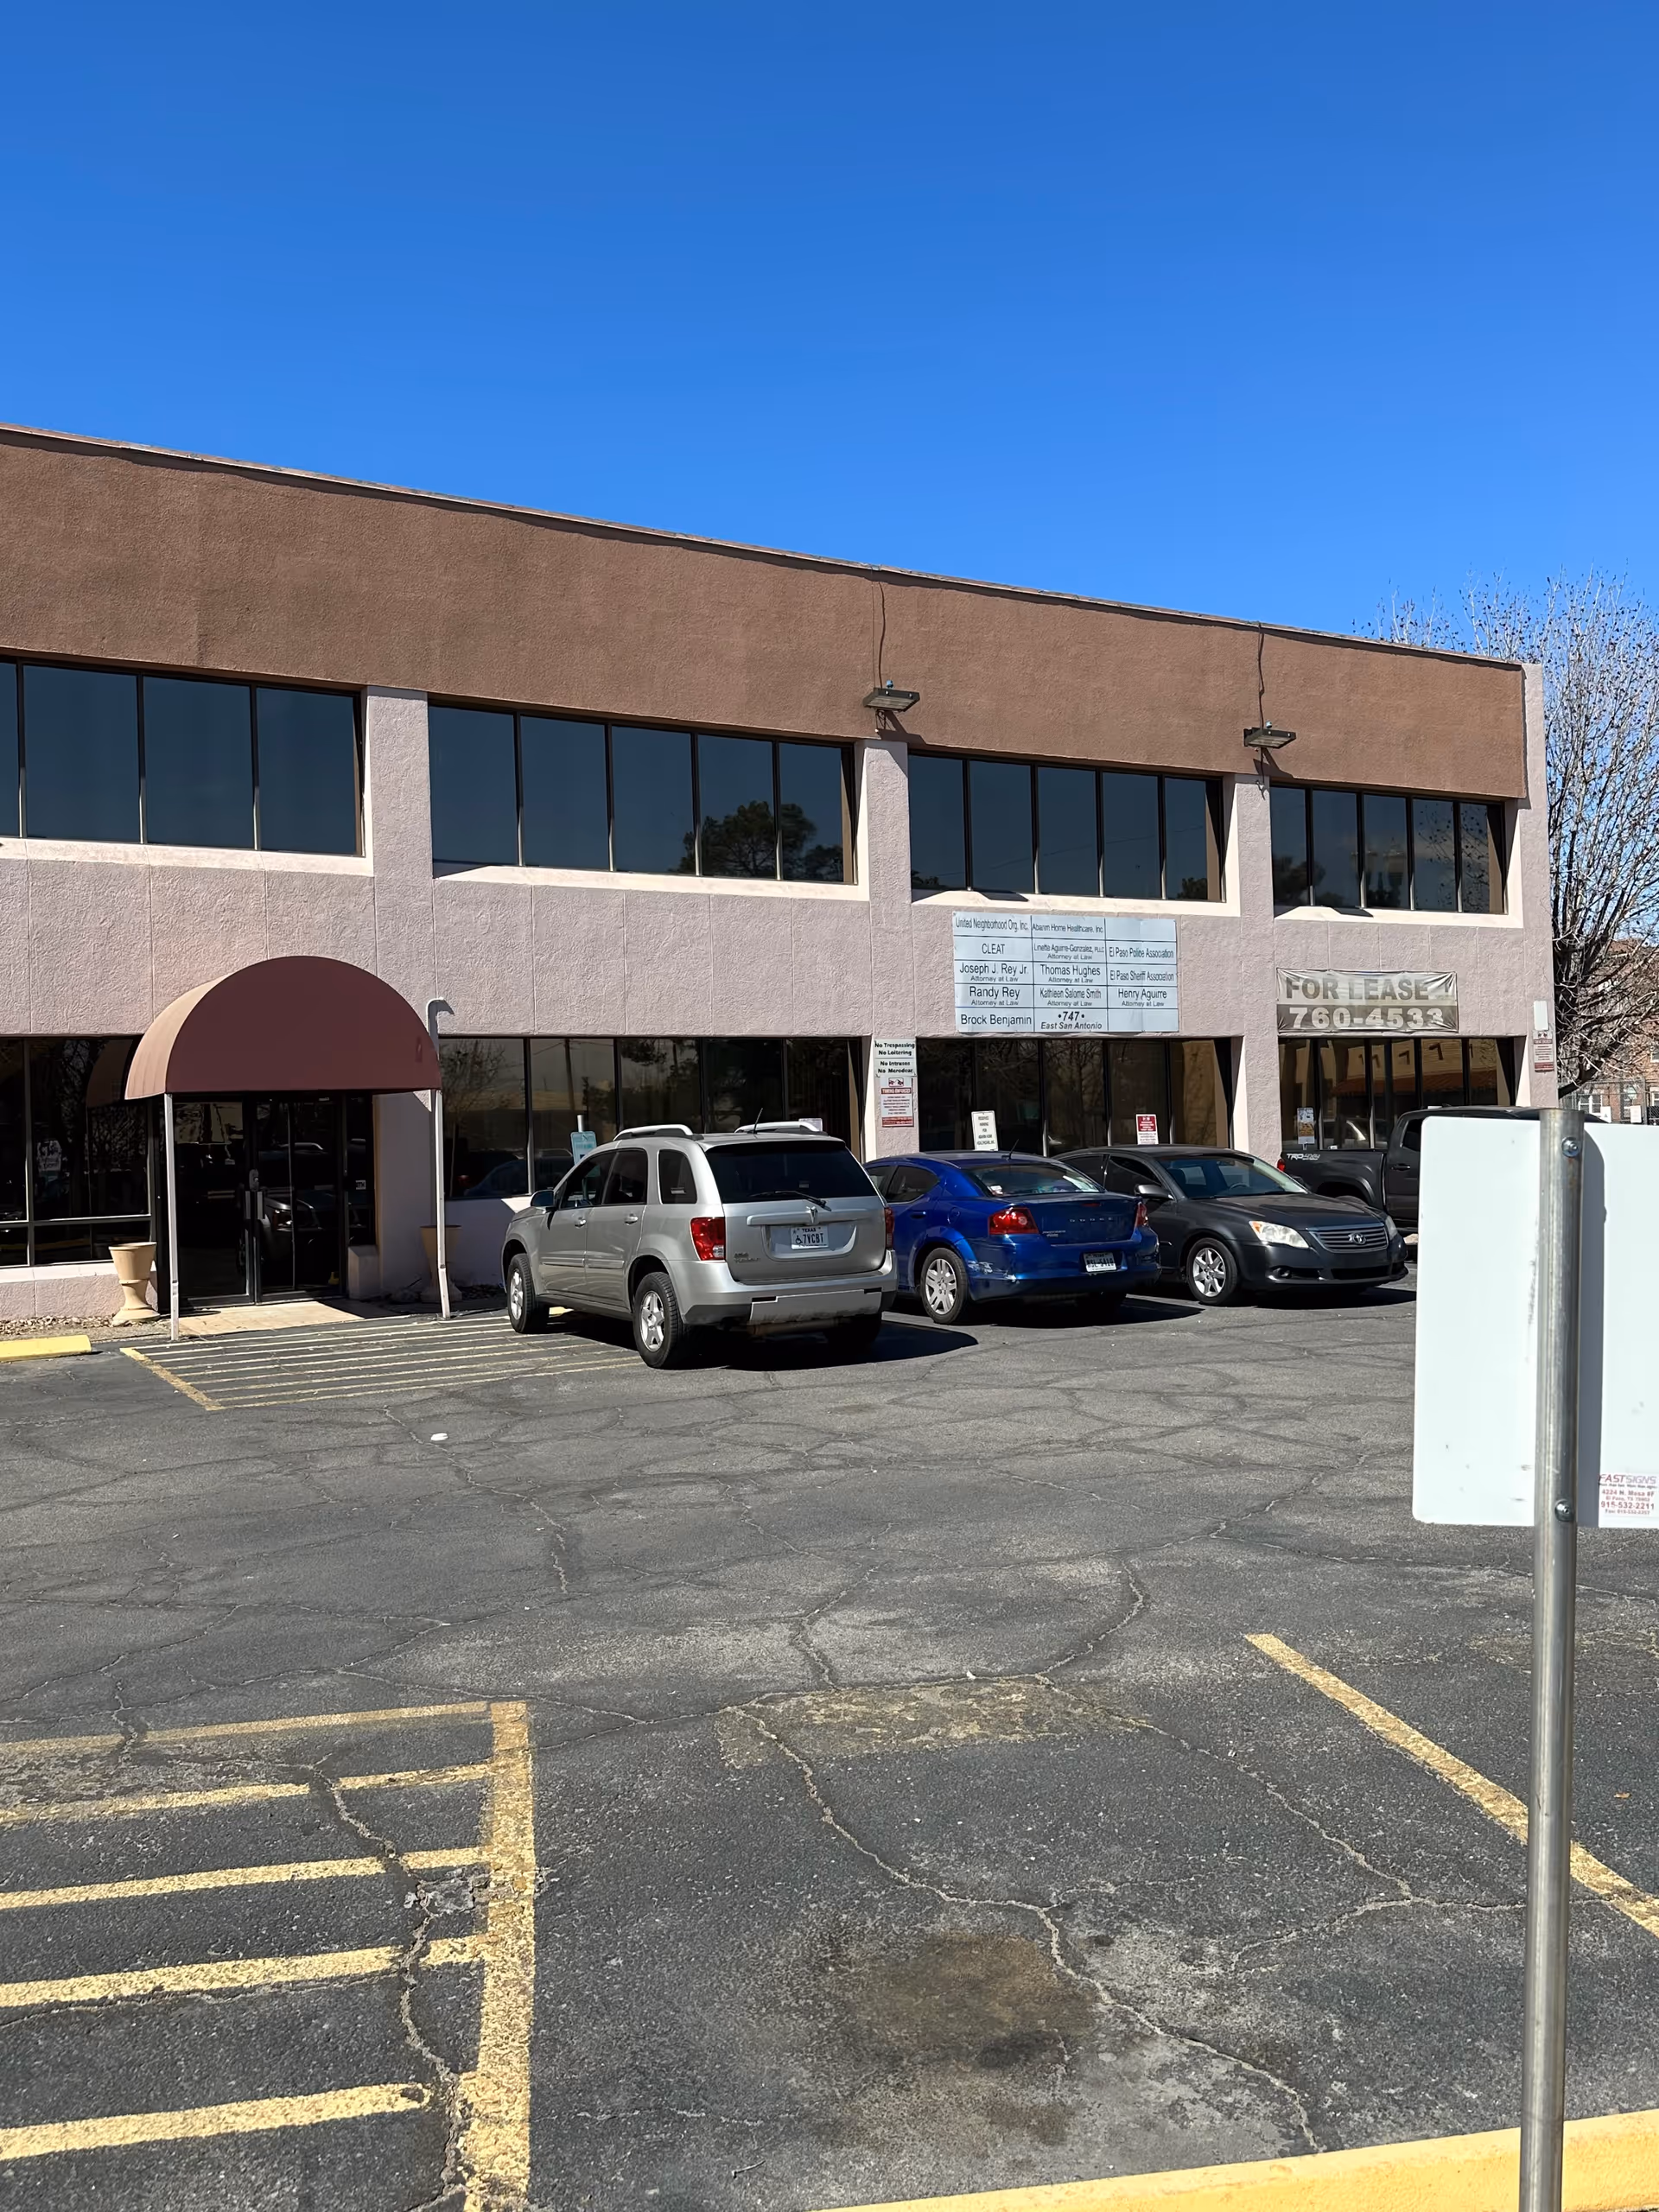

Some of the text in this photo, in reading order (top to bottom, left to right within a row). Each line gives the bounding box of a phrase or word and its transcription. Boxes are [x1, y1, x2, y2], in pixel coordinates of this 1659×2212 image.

[956, 917, 972, 928] United
[973, 918, 1007, 931] Neighborhood
[1051, 924, 1066, 932] Home
[982, 943, 1005, 954] CLEAT
[1109, 946, 1174, 958] El Paso Police Association
[960, 963, 989, 976] Joseph
[1001, 963, 1018, 976] Rey
[1040, 964, 1101, 978] Thomas Hughes
[1109, 969, 1175, 982] El Paso Sheriff Association
[969, 986, 1020, 1000] Randy Rey
[1039, 988, 1102, 999] Kathleen Salome Smith
[1118, 988, 1167, 1001] Henry Aguirre
[1286, 977, 1338, 1000] FOR
[1348, 978, 1429, 1001] LEASE
[961, 1014, 1032, 1027] Brock Benjamin
[1288, 1007, 1445, 1030] 760-4533
[1040, 1021, 1103, 1030] East San Antonio
[1599, 1474, 1656, 1484] FASTSIGNS
[1601, 1501, 1654, 1510] 915-532-2211
